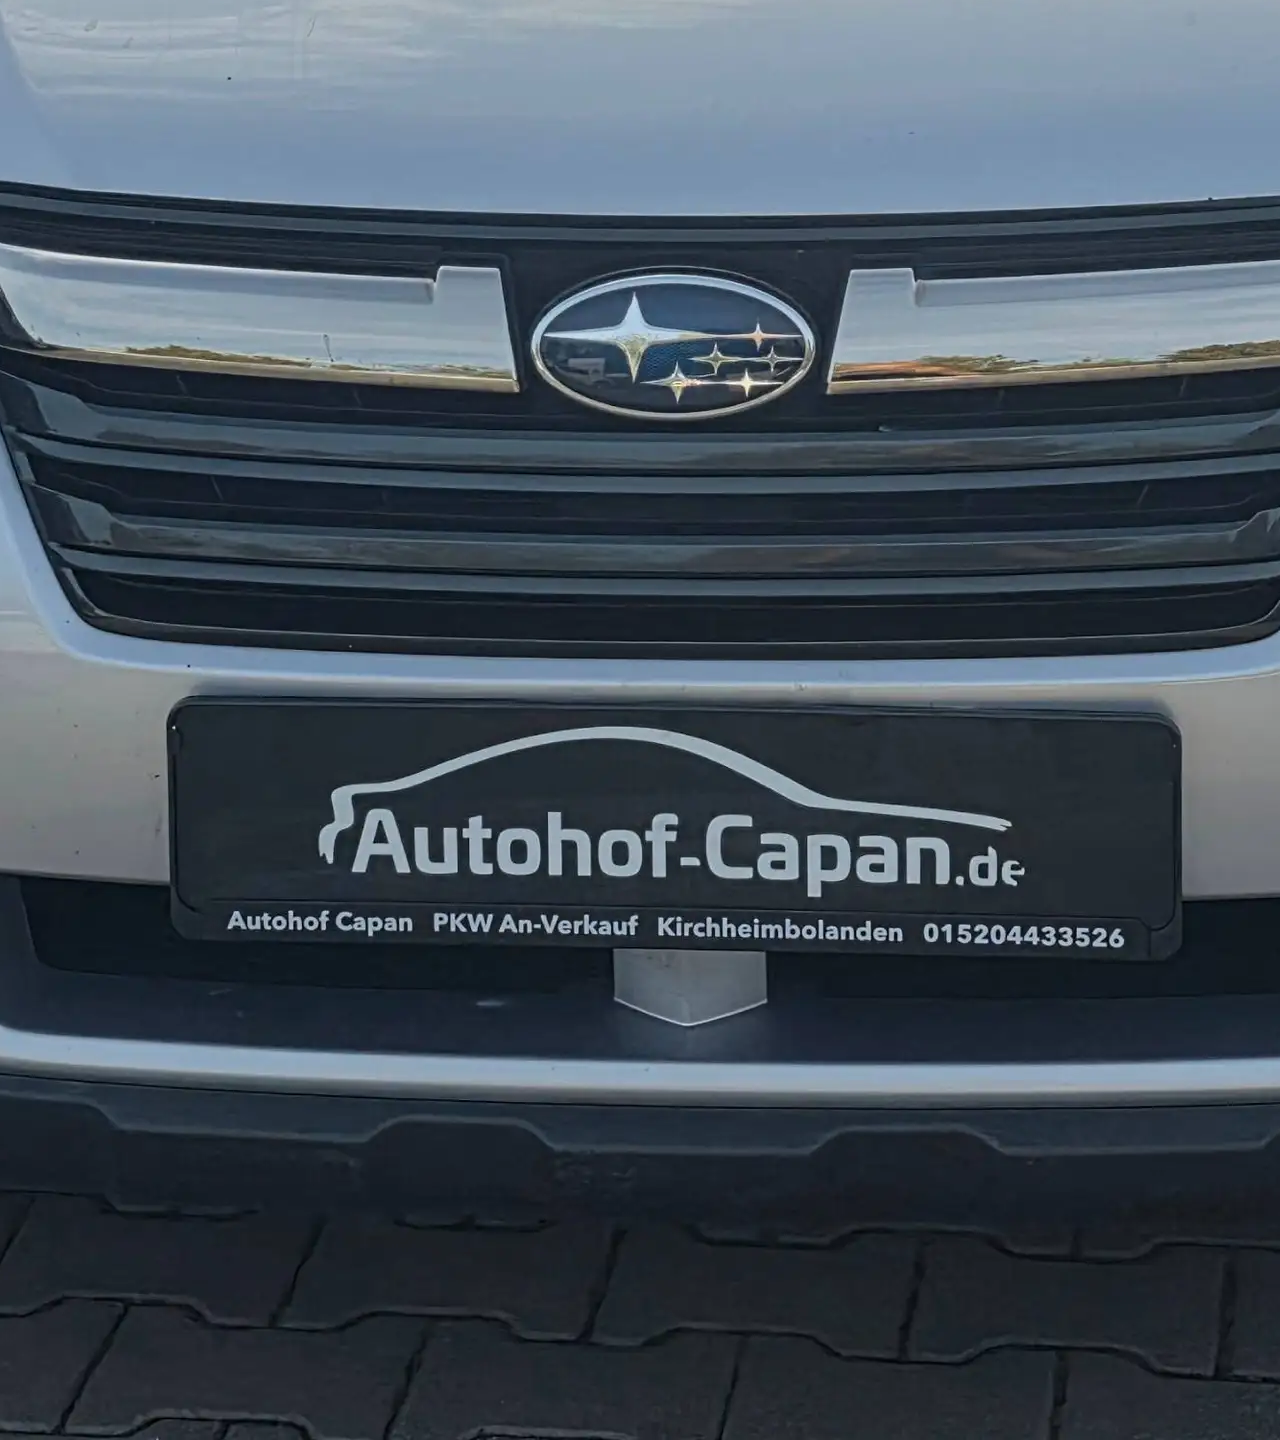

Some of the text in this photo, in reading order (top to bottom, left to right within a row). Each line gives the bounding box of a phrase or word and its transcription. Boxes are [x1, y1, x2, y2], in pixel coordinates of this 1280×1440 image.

[351, 807, 1027, 899] Autohof-Capan.de
[227, 910, 1125, 948] Autohof Capan PKW An-Verkauf Kirchheimbolanden 015204433526
